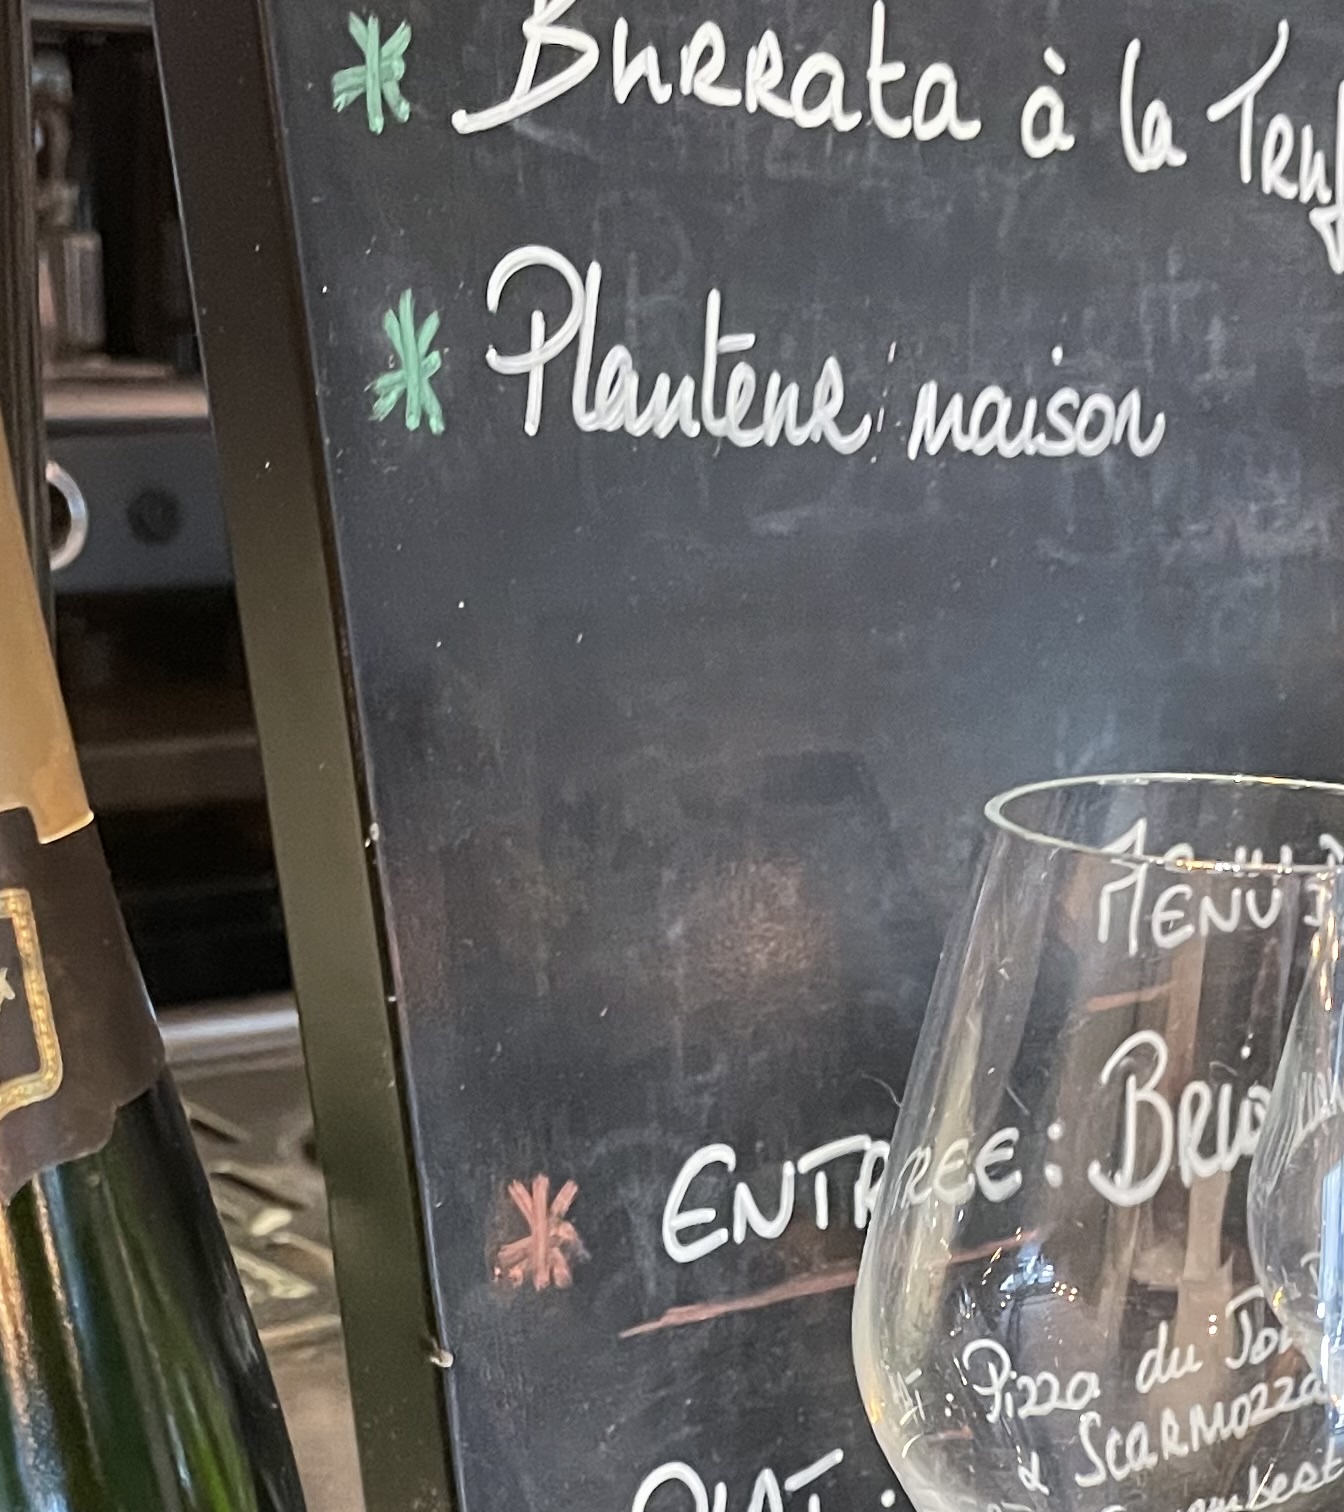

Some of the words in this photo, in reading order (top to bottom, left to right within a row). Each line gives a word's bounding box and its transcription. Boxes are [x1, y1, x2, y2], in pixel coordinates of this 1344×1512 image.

[1020, 46, 1076, 158] à
[1119, 38, 1188, 173] la
[907, 344, 1167, 461] maison
[962, 1338, 1101, 1424] Pizza
[1135, 1319, 1204, 1394] du
